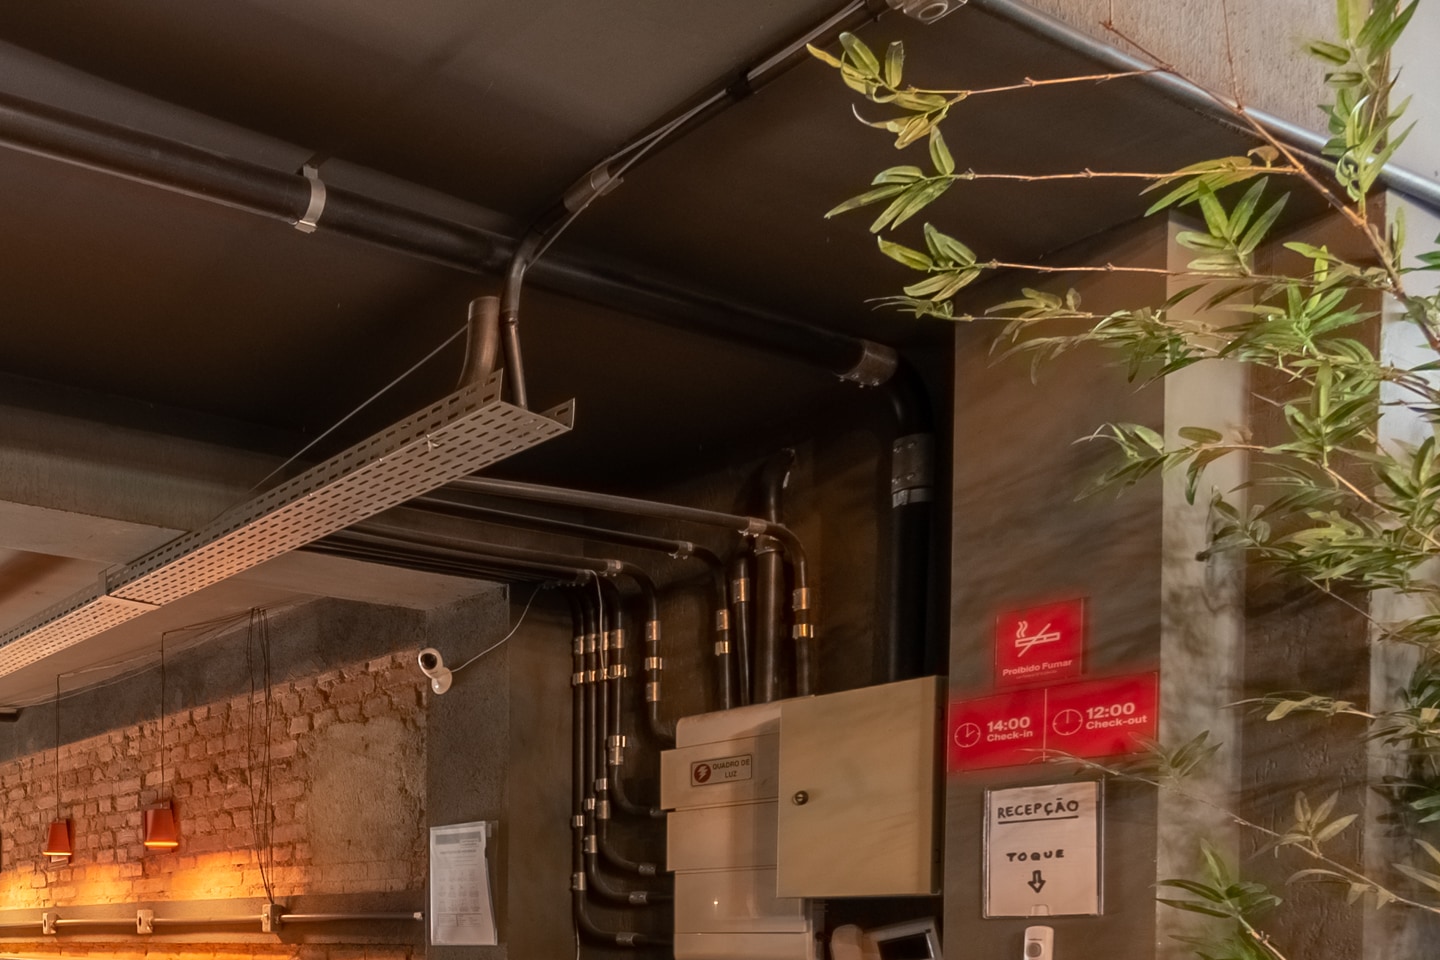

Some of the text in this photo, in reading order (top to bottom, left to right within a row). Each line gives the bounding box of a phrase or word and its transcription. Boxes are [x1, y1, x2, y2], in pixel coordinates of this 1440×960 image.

[1002, 664, 1041, 677] Proibido
[1042, 660, 1072, 670] Fumar
[1086, 702, 1135, 720] 12:00
[987, 716, 1031, 732] 14:00
[1085, 714, 1148, 730] Check-out
[987, 729, 1033, 742] Check-in
[712, 758, 750, 770] QUADRO DE
[724, 770, 738, 779] LUZ
[997, 797, 1079, 819] RECEPÇÃO
[1006, 849, 1065, 862] TOQUE
